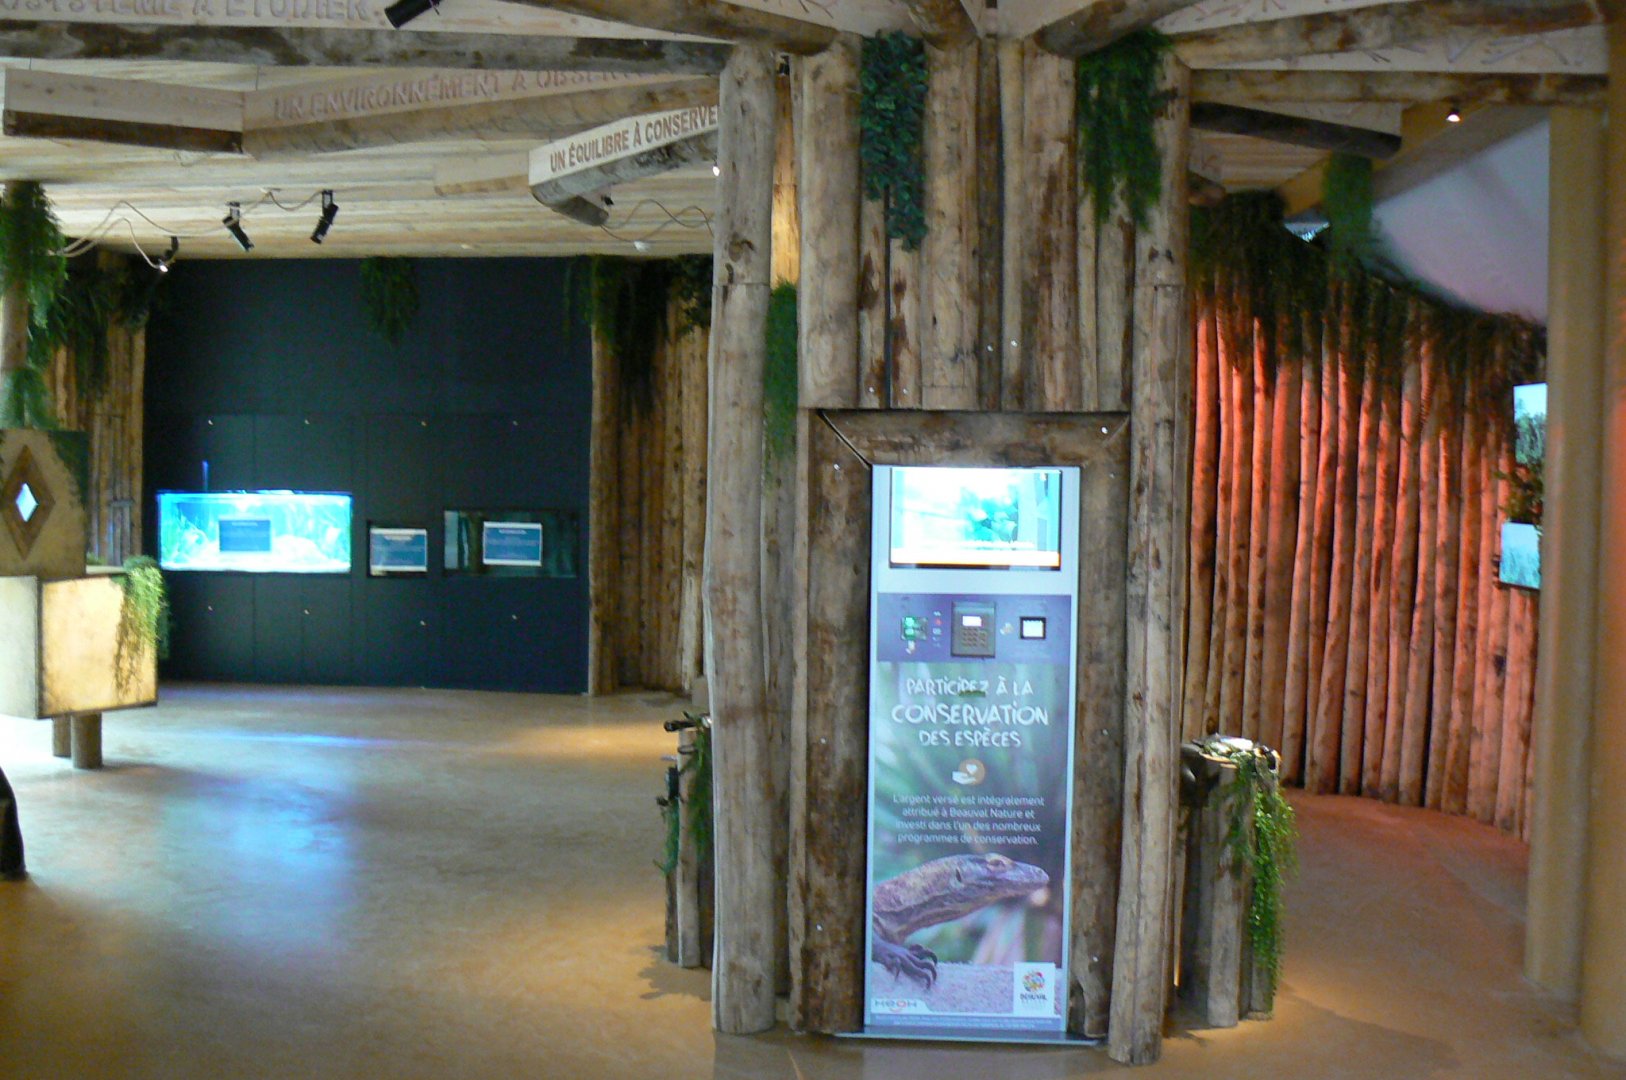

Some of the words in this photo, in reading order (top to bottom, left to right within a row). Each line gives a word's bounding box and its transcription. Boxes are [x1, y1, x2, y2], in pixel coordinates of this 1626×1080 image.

[550, 149, 567, 173] UN
[568, 129, 630, 167] ÉQUILIBRE
[632, 120, 642, 147] À
[645, 104, 719, 144] CONSERVE
[996, 675, 1007, 696] À
[1013, 680, 1034, 695] LA
[918, 729, 951, 747] DES
[954, 727, 1022, 747] ESPÈCES
[960, 795, 976, 805] est
[902, 806, 939, 818] attribué
[949, 807, 988, 818] Beauval
[989, 808, 1023, 819] Nature
[1024, 809, 1036, 819] et
[928, 820, 951, 831] dans
[973, 821, 990, 832] des
[992, 821, 1041, 833] nombreux
[897, 833, 959, 845] programmes
